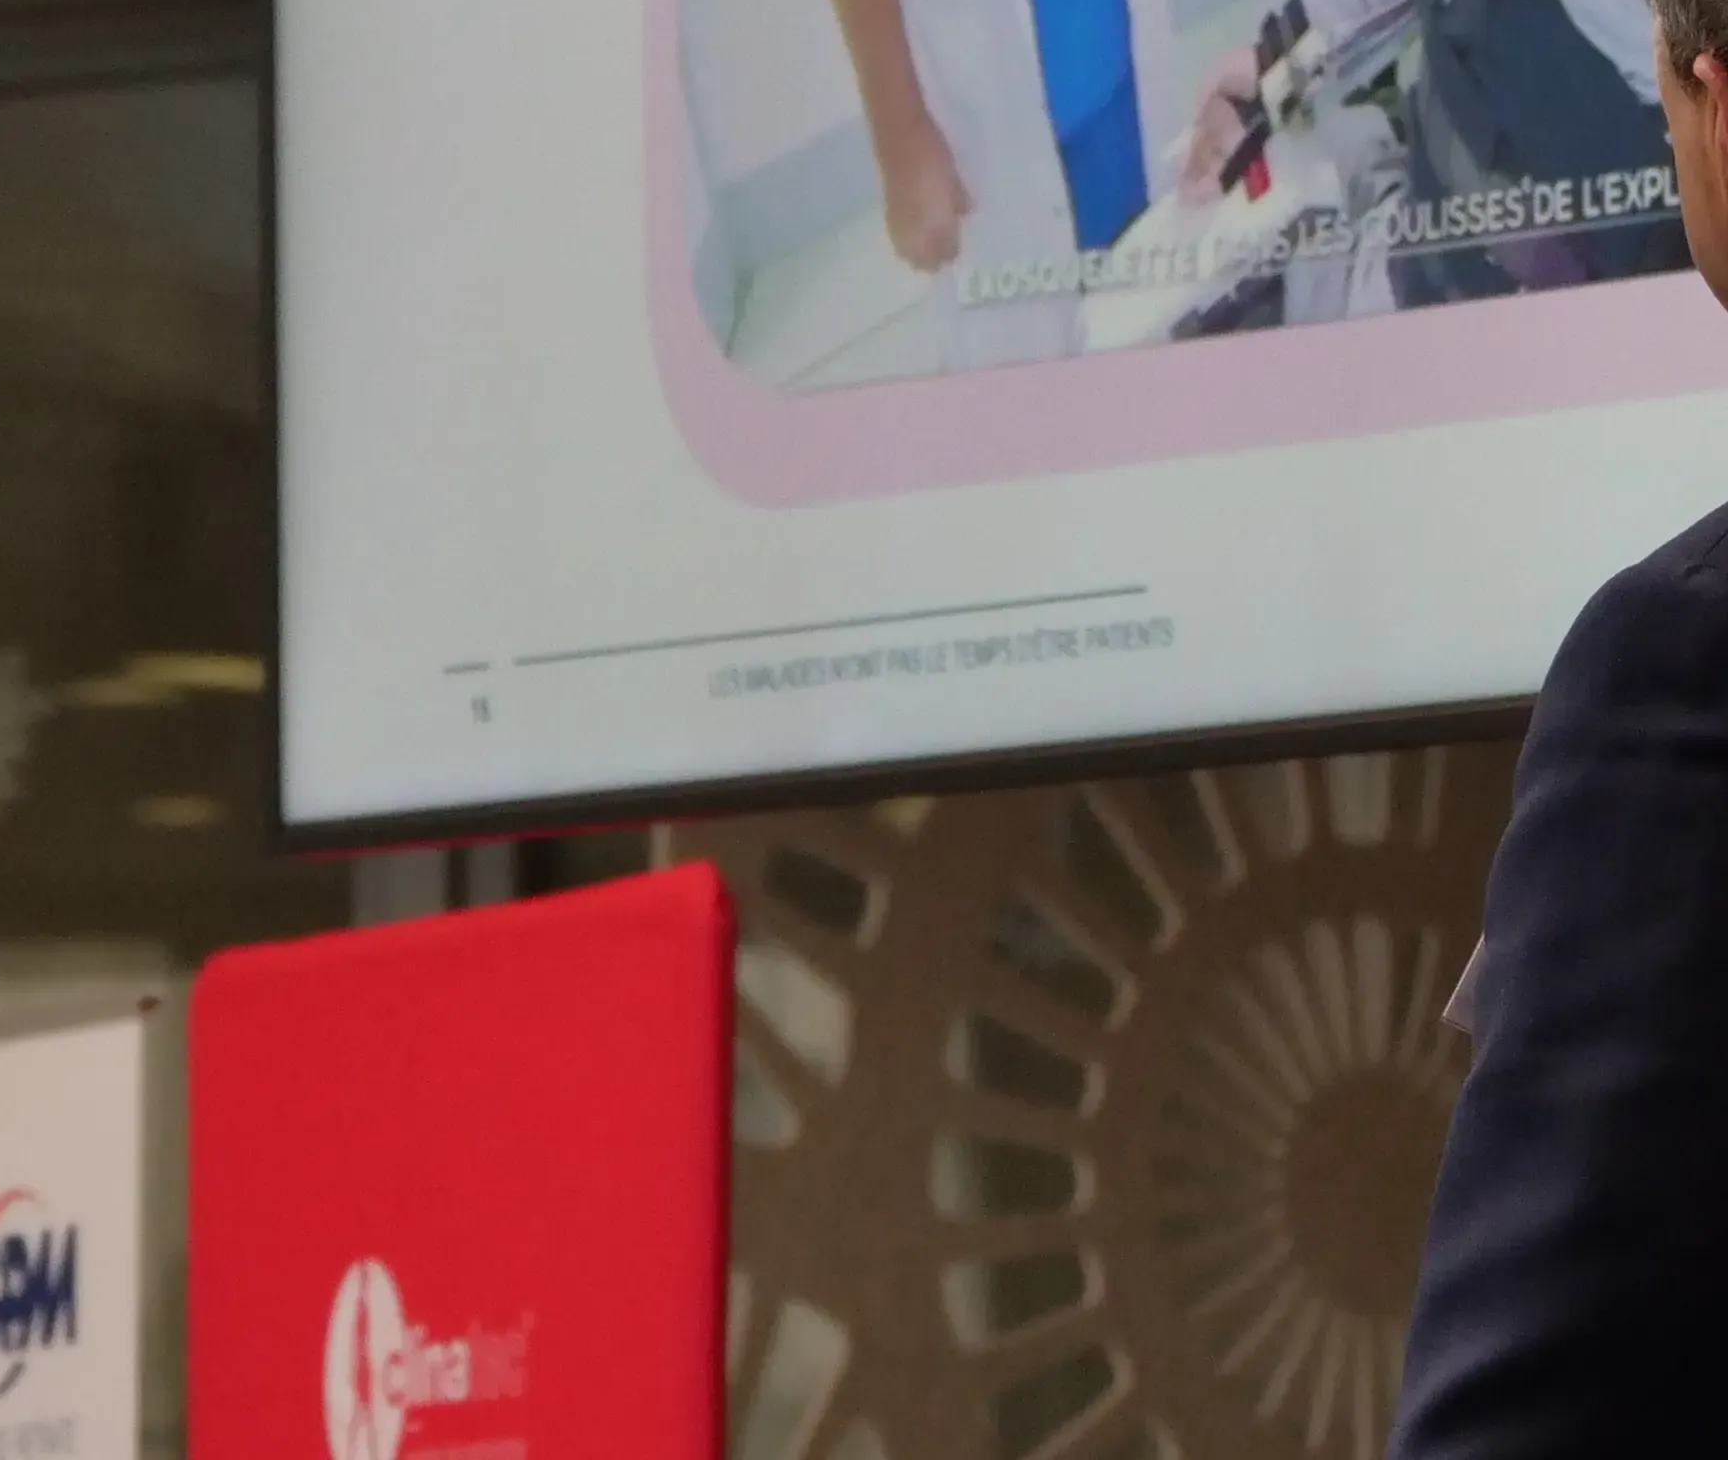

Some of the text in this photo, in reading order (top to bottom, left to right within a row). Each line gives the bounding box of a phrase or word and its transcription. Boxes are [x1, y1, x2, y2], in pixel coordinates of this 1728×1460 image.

[1298, 211, 1354, 258] LES
[1360, 188, 1525, 244] COULISSES
[1532, 179, 1573, 226] DE
